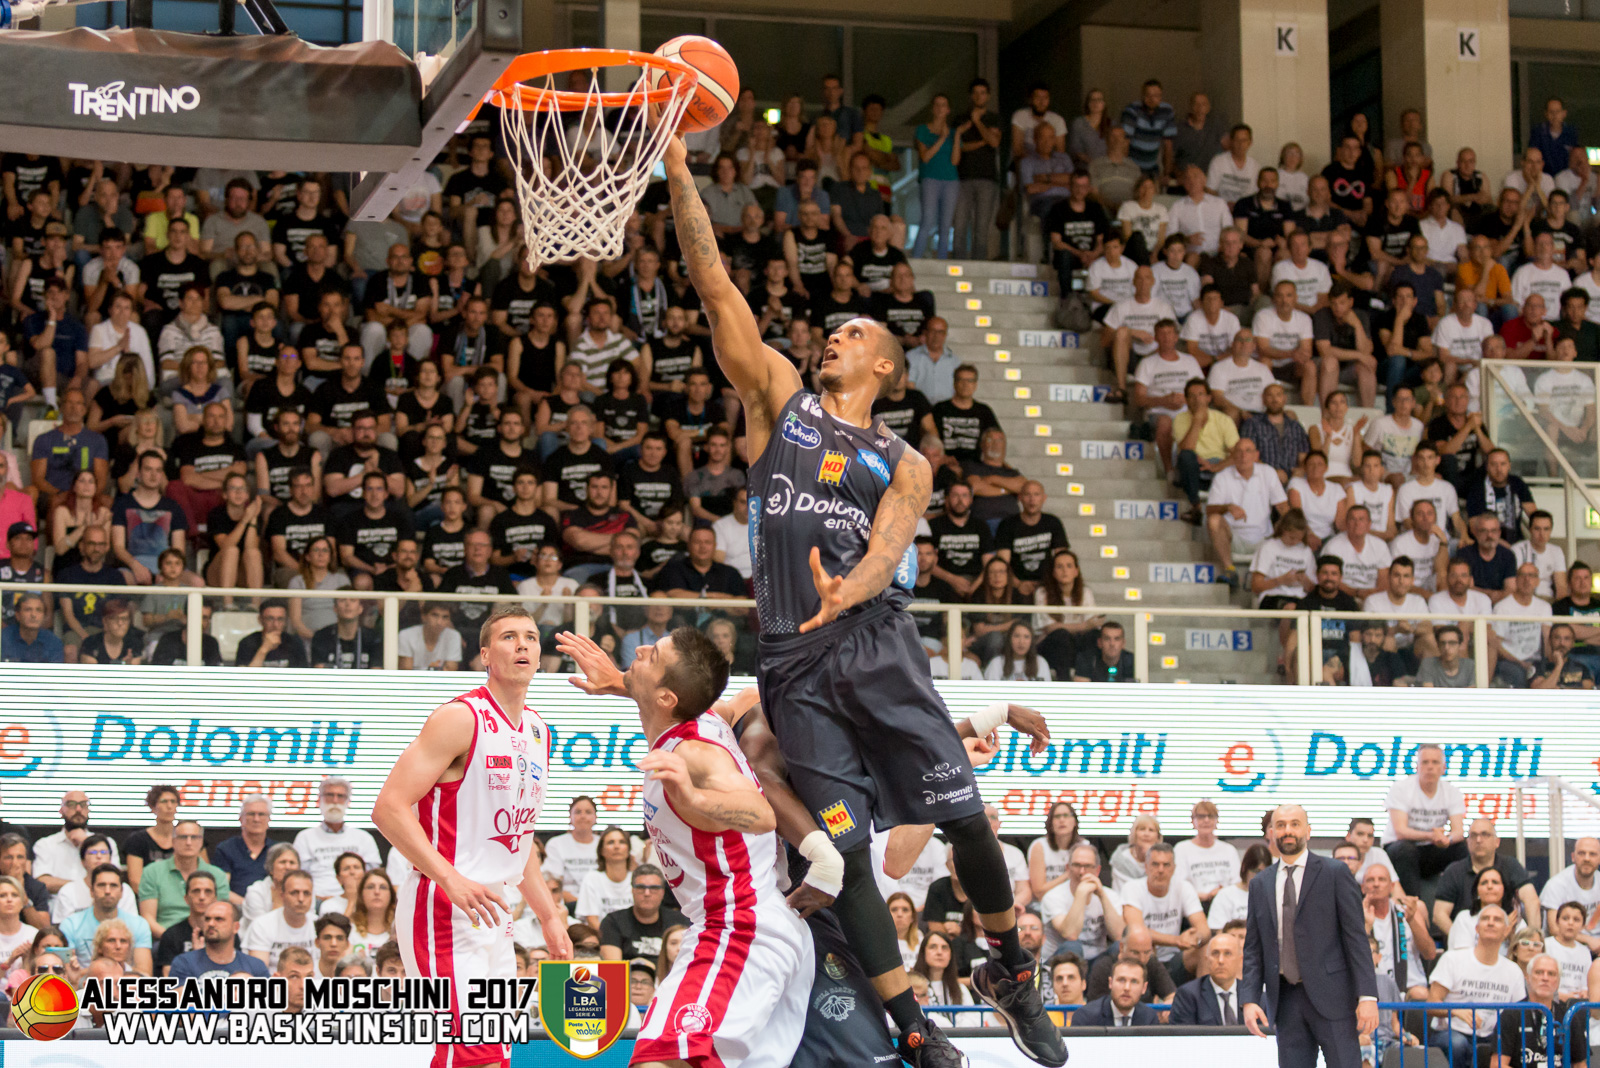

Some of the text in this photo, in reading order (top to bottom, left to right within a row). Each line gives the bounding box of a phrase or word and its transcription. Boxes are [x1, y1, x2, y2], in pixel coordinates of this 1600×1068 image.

[1278, 27, 1295, 51] K
[1459, 32, 1476, 57] K
[68, 82, 201, 121] TRENTINO
[994, 283, 1029, 294] FILA
[1024, 333, 1058, 345] FILA
[1055, 387, 1089, 402] FILA
[783, 421, 819, 445] Melinda
[1086, 444, 1140, 459] FILA 6
[822, 460, 843, 473] MD
[1119, 503, 1175, 519] FILA 5
[1154, 566, 1210, 582] FILA 4
[1191, 632, 1249, 649] FILA 3
[479, 709, 499, 733] 15
[87, 714, 363, 765] Dolomiti
[922, 765, 962, 782] CAVIT
[937, 785, 973, 801] Dolomiti
[950, 793, 974, 804] energia
[826, 810, 848, 828] MD
[1462, 979, 1510, 993] #WEDIEHARD
[1460, 990, 1491, 1000] PLAYOFF
